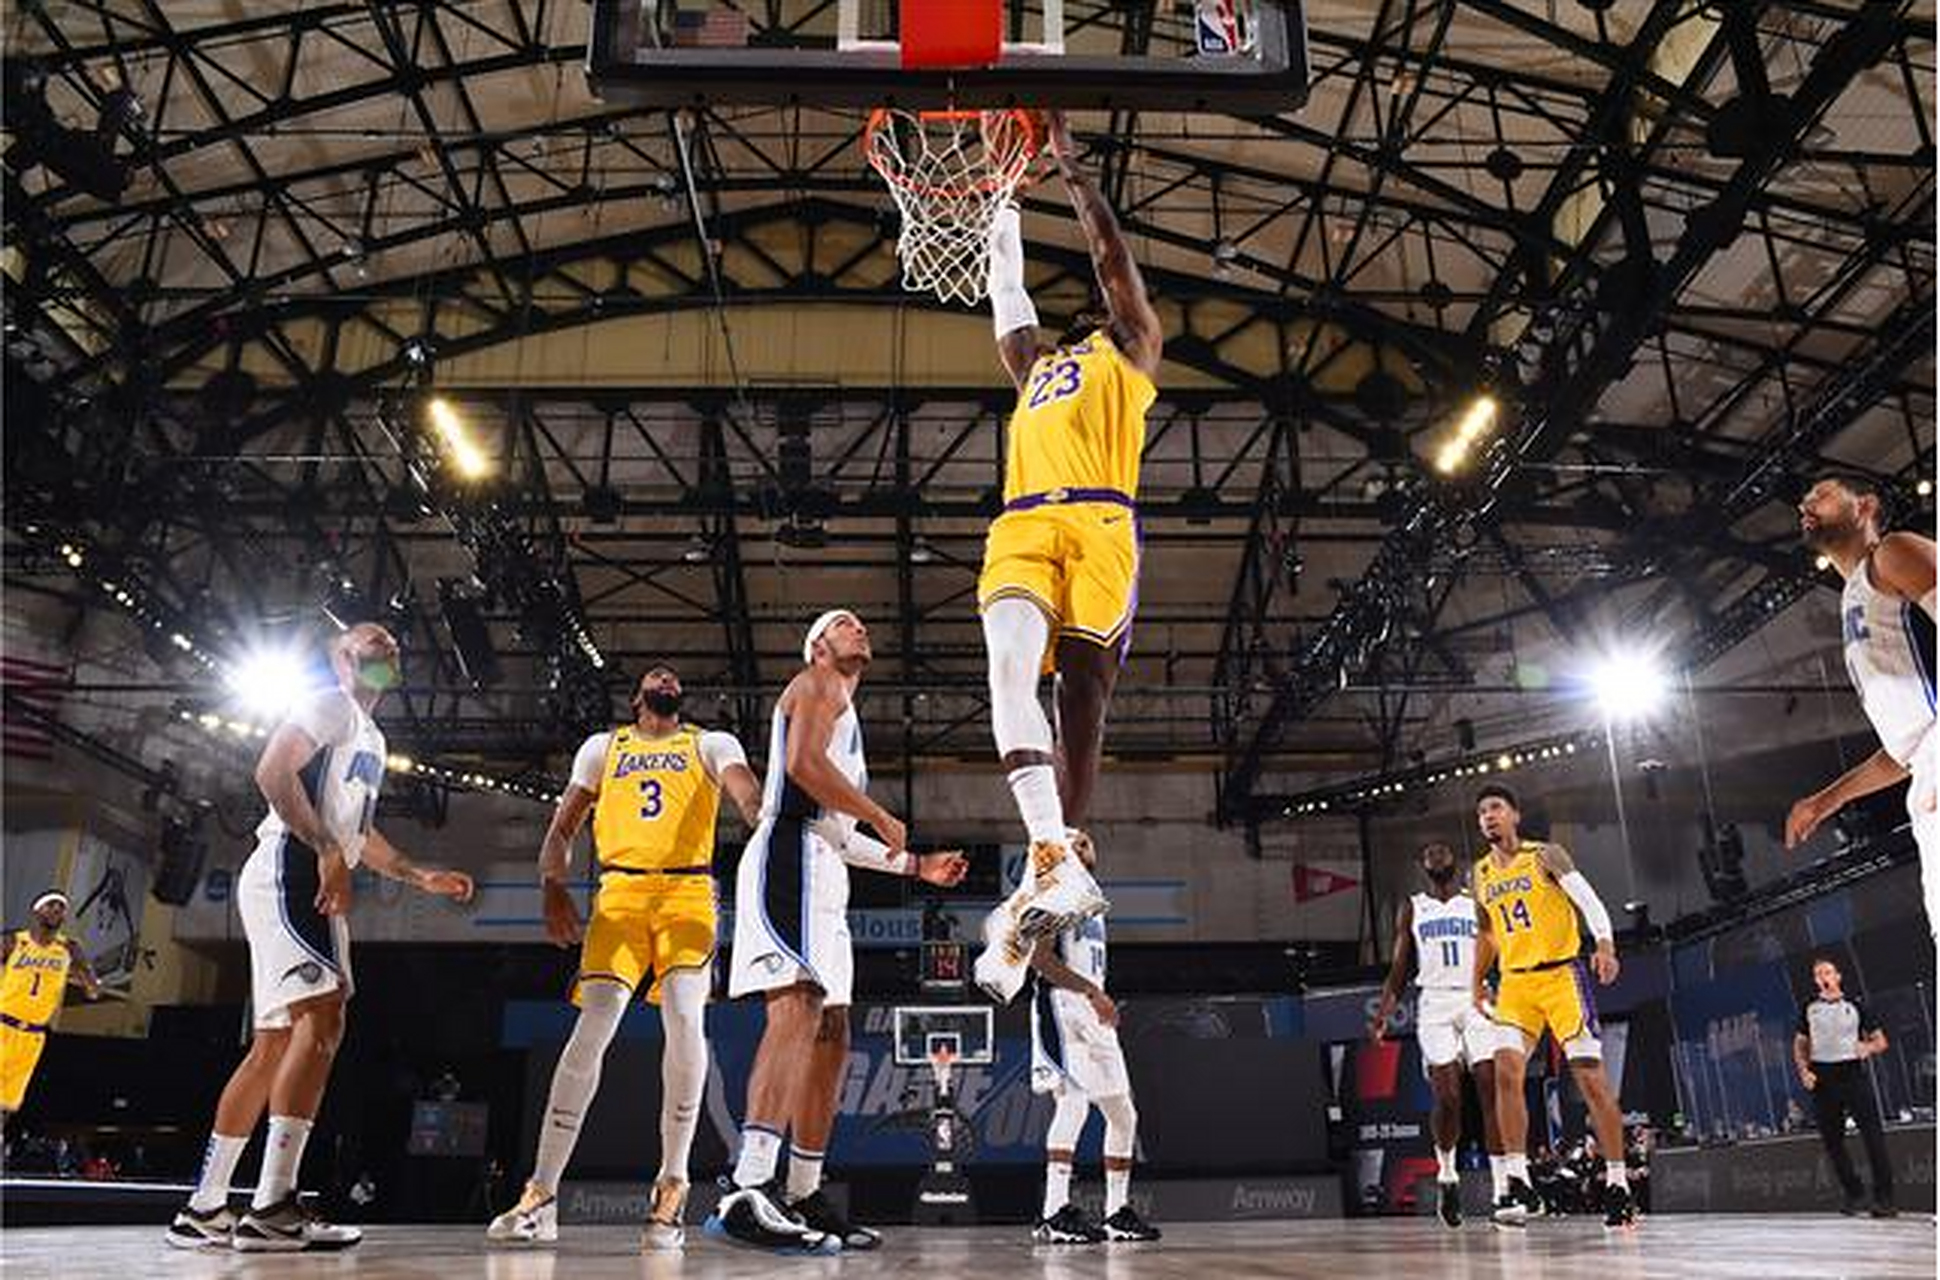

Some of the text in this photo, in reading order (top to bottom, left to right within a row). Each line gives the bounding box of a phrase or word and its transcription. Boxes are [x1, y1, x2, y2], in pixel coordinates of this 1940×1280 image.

[1028, 359, 1080, 409] 23
[613, 753, 687, 778] LAKERS
[641, 779, 661, 818] 3
[1499, 898, 1531, 933] 14
[1442, 941, 1459, 966] 11
[30, 972, 40, 997] 1
